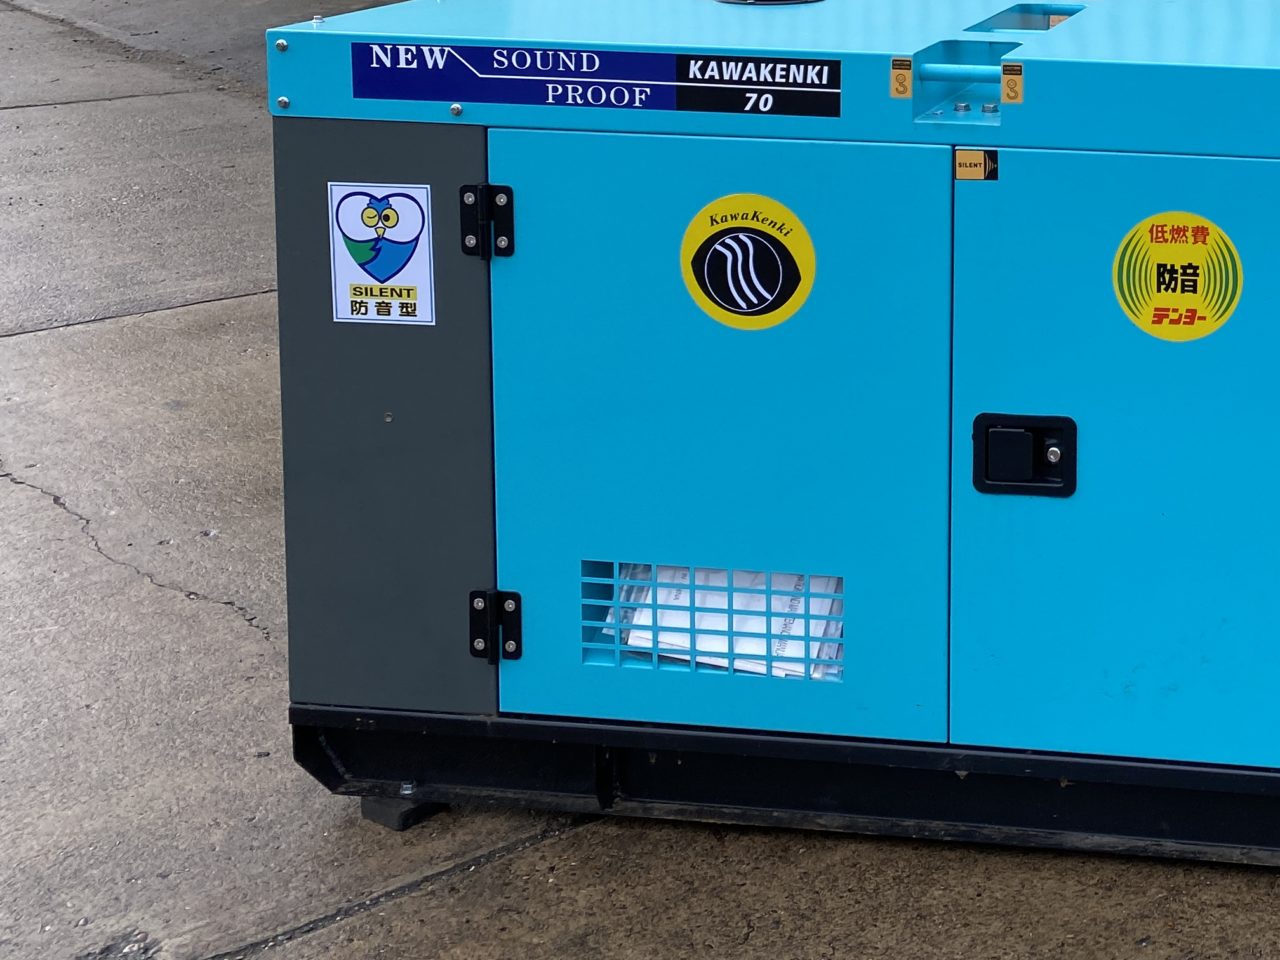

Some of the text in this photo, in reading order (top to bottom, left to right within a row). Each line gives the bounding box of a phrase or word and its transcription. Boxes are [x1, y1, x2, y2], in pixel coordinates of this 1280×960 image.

[369, 44, 600, 72] NEW SOUND
[688, 60, 829, 85] KAWAKENKI
[545, 83, 651, 107] PROOF
[744, 93, 773, 112] 70
[709, 210, 793, 237] KawaKenki
[1148, 223, 1210, 246] 低燃費
[1156, 262, 1200, 294] 防音
[352, 286, 414, 299] SILENT
[350, 300, 418, 317] 防音型
